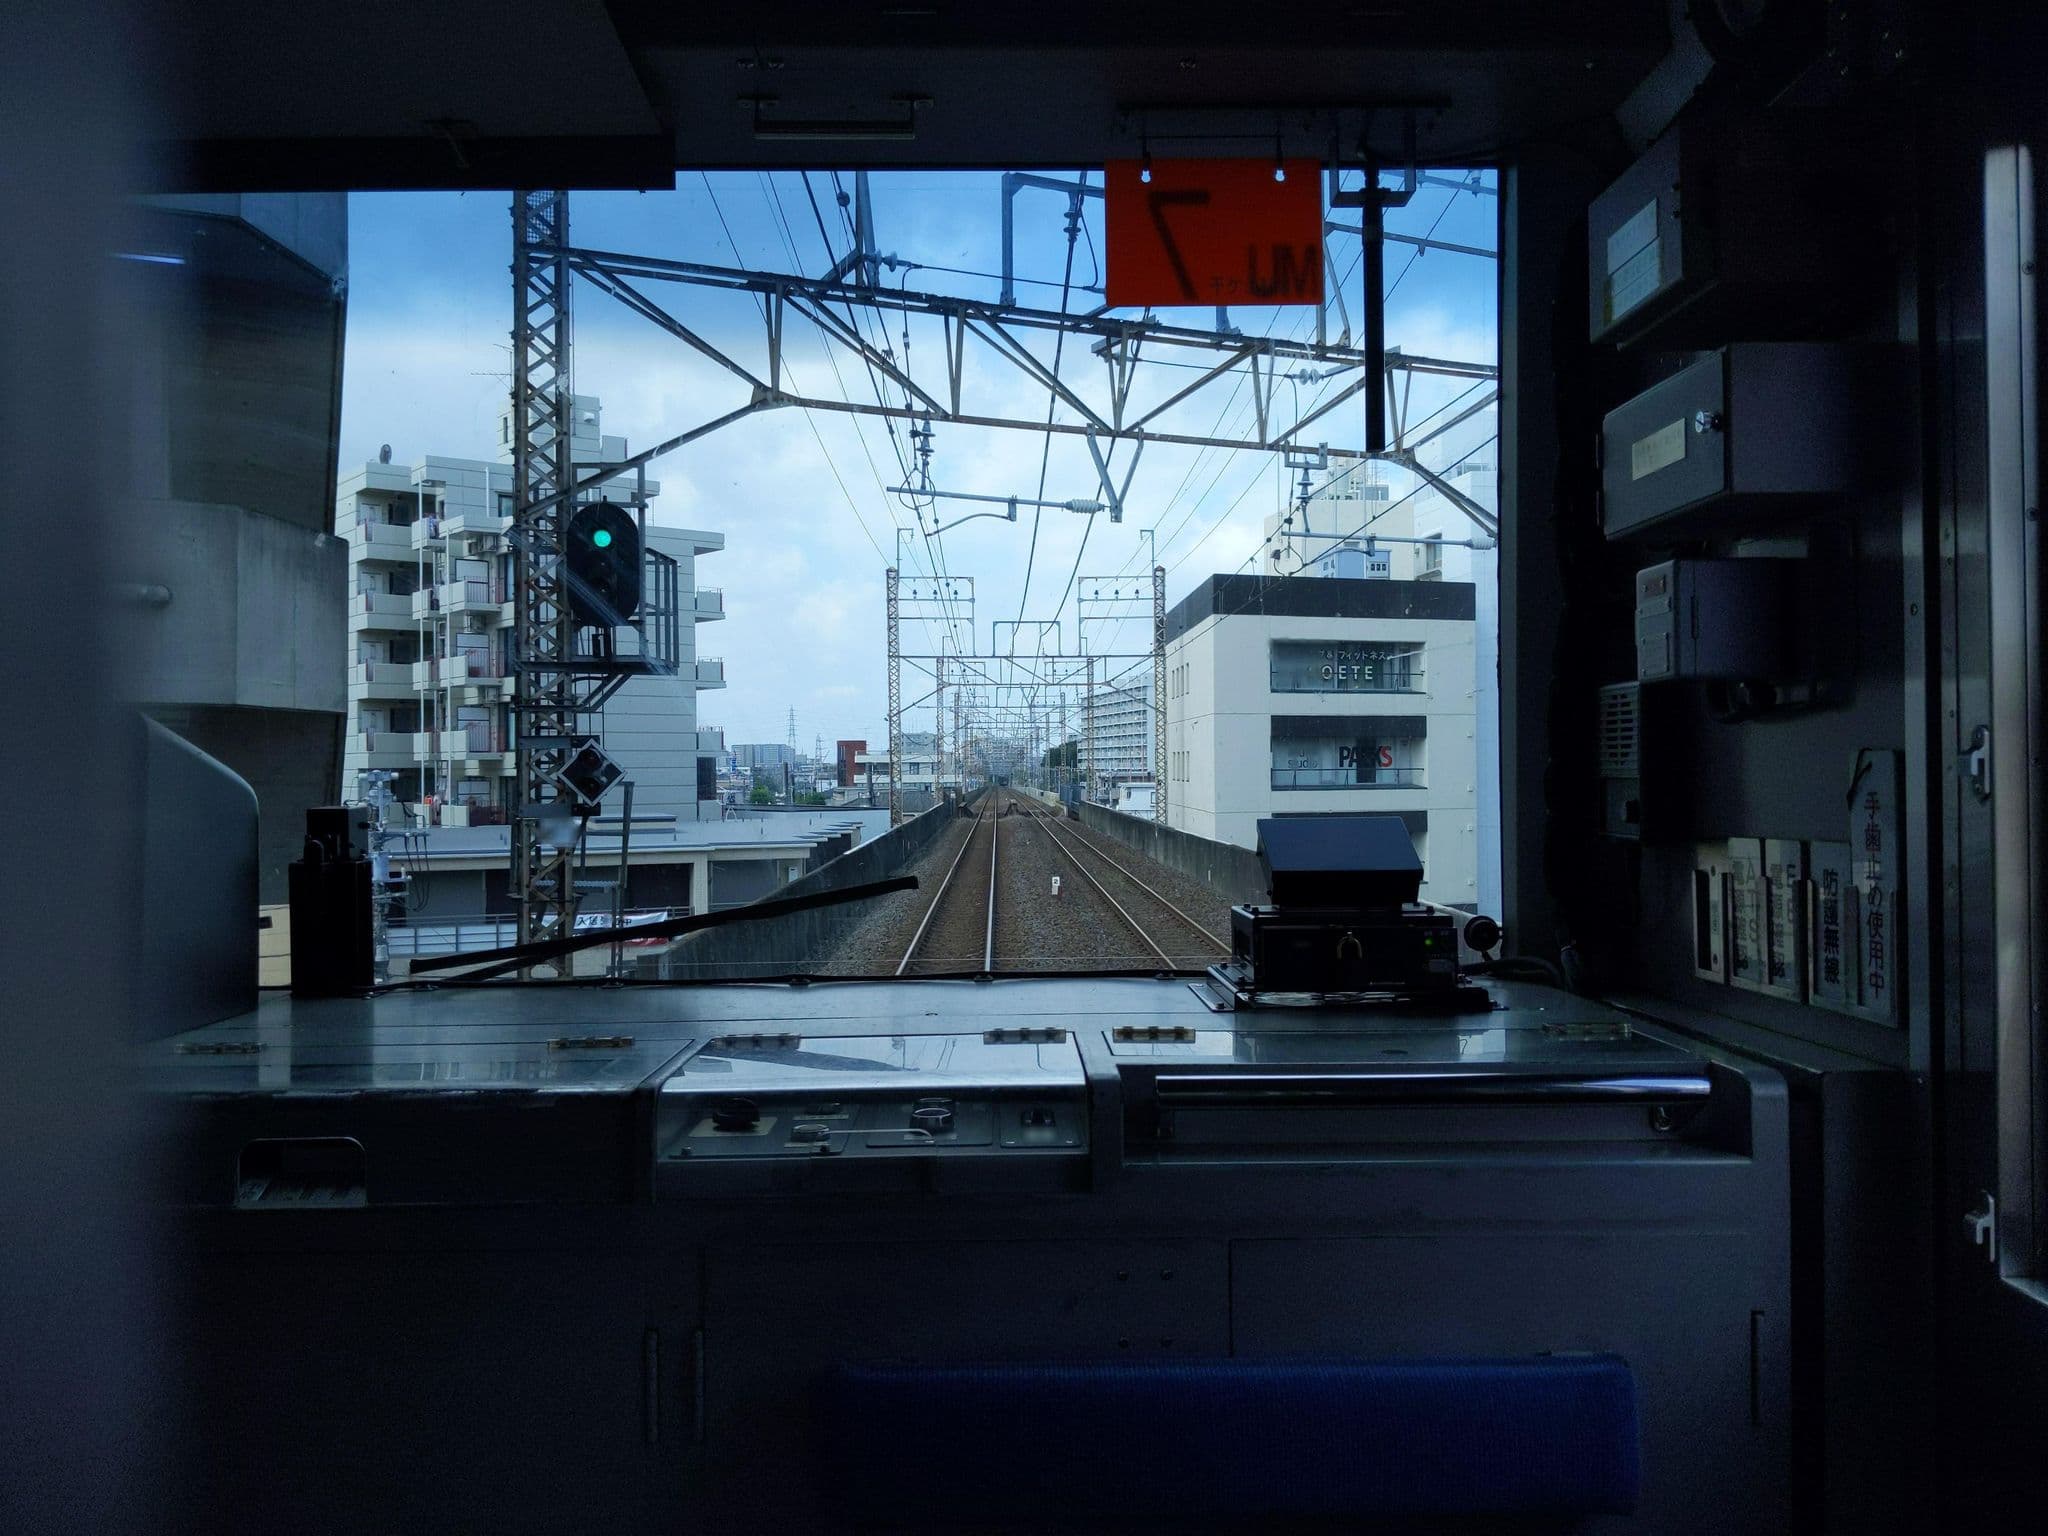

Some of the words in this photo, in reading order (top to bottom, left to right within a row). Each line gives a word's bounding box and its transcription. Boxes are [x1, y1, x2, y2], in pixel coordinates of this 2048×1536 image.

[1339, 746, 1393, 768] PAS
[1863, 791, 1885, 1002] 手歯止め使用中
